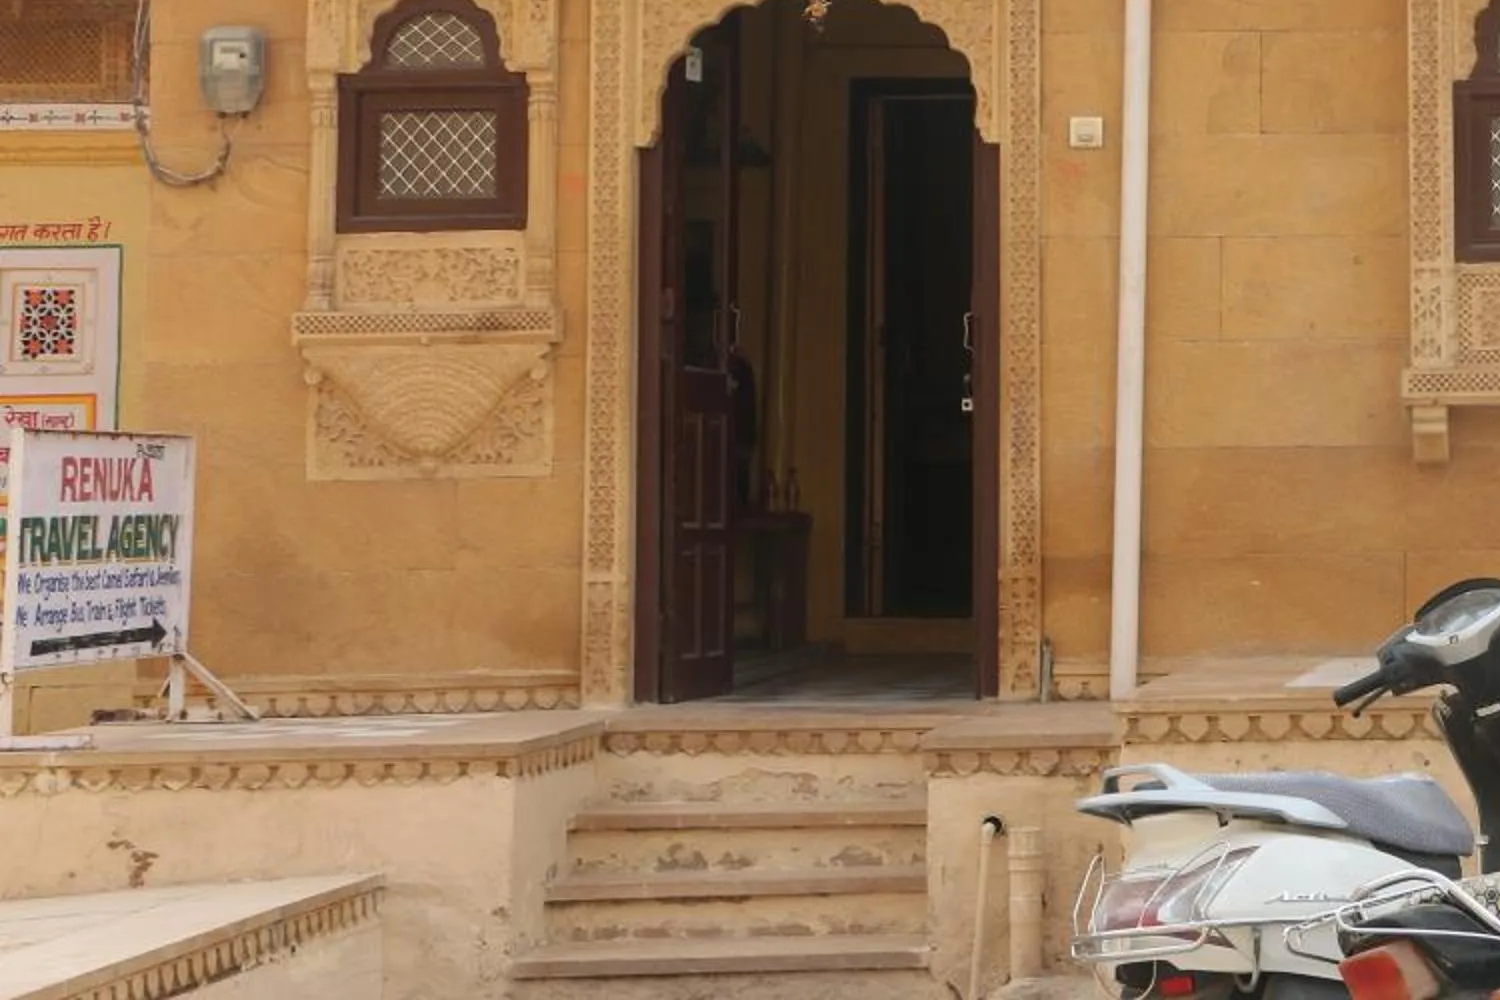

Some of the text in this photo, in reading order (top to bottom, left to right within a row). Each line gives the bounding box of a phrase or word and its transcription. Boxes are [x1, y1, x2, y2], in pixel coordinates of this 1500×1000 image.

[60, 456, 154, 502] RENUKA
[19, 514, 179, 564] TRAVEL AGENCY
